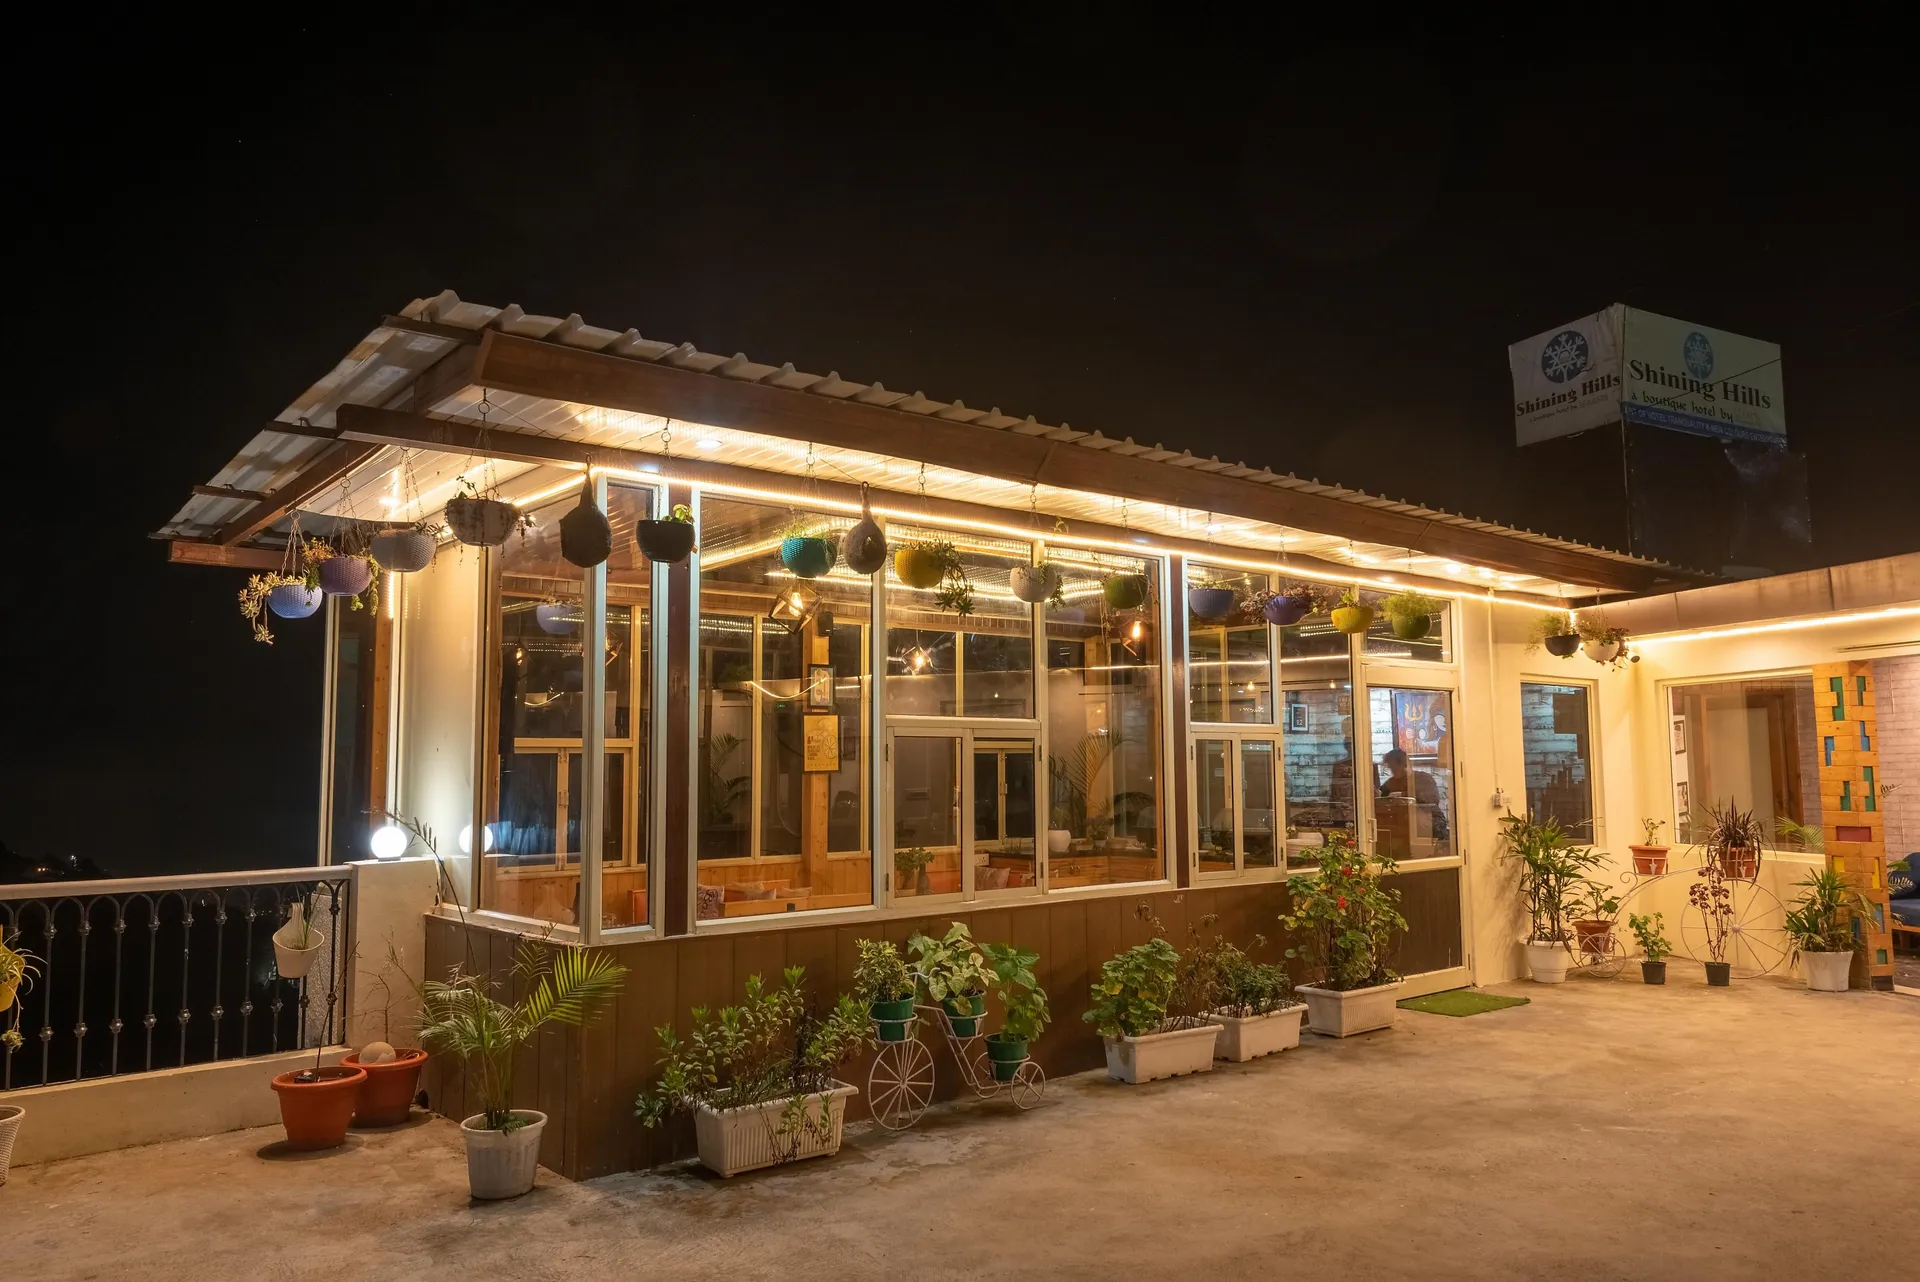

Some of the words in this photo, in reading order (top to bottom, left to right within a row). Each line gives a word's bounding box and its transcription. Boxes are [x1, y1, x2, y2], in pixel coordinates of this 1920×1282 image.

[1516, 389, 1577, 416] Shining
[1581, 374, 1621, 396] Hills
[1630, 359, 1715, 402] Shining
[1723, 382, 1771, 409] Hills
[1631, 391, 1637, 400] a
[1643, 391, 1687, 412] boutique
[1691, 401, 1716, 417] hotel
[1720, 408, 1734, 424] by
